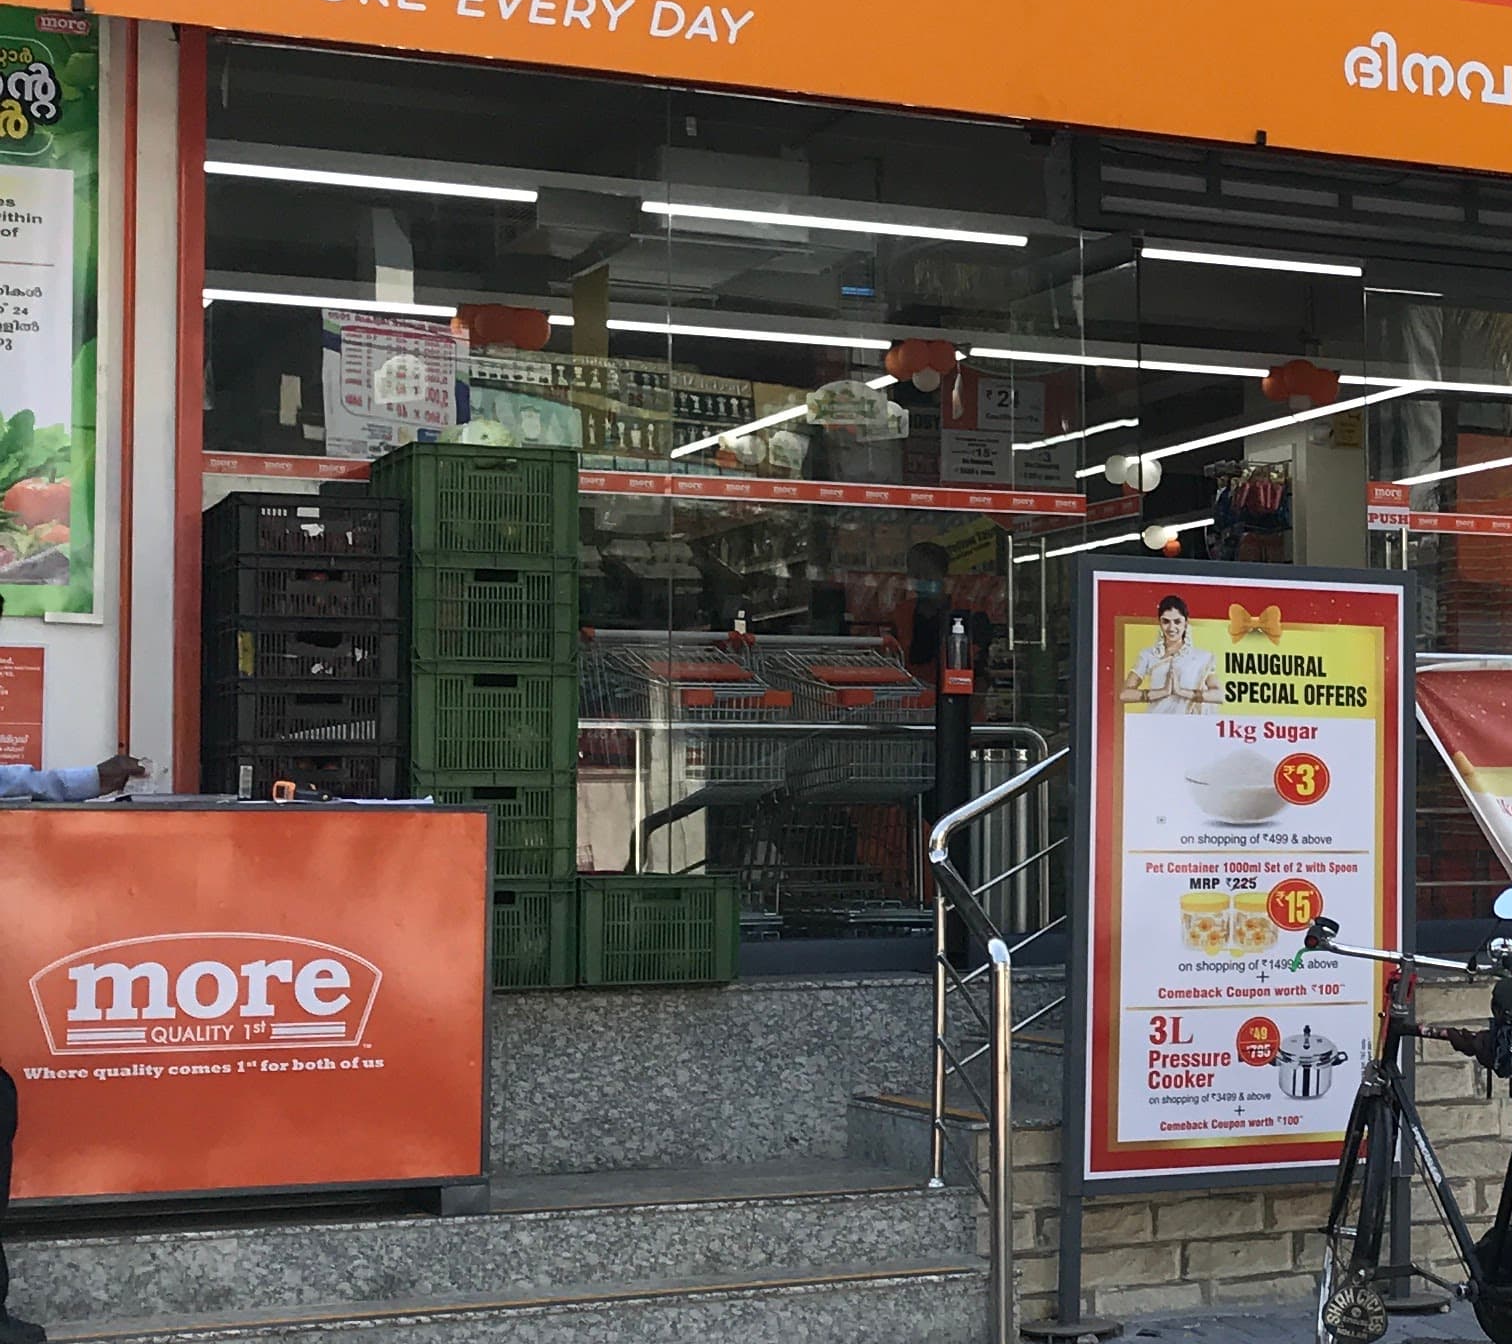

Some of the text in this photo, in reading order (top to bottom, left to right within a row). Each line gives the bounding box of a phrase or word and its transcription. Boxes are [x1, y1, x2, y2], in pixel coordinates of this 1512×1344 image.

[41, 16, 87, 30] more
[648, 1, 754, 45] DAY
[13, 306, 29, 316] 24
[1374, 487, 1402, 498] more
[1367, 512, 1409, 524] PUSH
[1225, 652, 1326, 678] INAUGURAL
[1225, 681, 1367, 707] SPECIAL OFFERS
[1216, 721, 1318, 743] 1kg Sugar
[1180, 835, 1194, 846] on
[1198, 834, 1247, 847] shopping
[1250, 833, 1260, 844] of
[1291, 835, 1299, 844] &
[1302, 834, 1332, 844] above
[1146, 862, 1358, 875] Pet Container 1000ml Set of with Spoon
[1190, 878, 1220, 889] MRP
[1178, 962, 1193, 971] on
[1195, 960, 1246, 973] shopping
[1248, 959, 1259, 970] of
[1307, 959, 1338, 969] above
[67, 958, 350, 1021] more
[1158, 985, 1306, 1000] Comeback Coupon worth
[151, 1020, 266, 1044] QUALITY 1st
[1149, 1015, 1194, 1045] 3L
[1148, 1050, 1231, 1069] Pressure
[23, 1056, 384, 1081] Where quality comes 1st for both of us
[1148, 1071, 1215, 1090] Cooker
[1149, 1096, 1160, 1105] on
[1162, 1095, 1199, 1107] shopping
[1201, 1093, 1210, 1103] of
[1246, 1092, 1272, 1101] above
[1160, 1117, 1274, 1132] Comeback Coupon worth
[1326, 1287, 1355, 1324] SHAH
